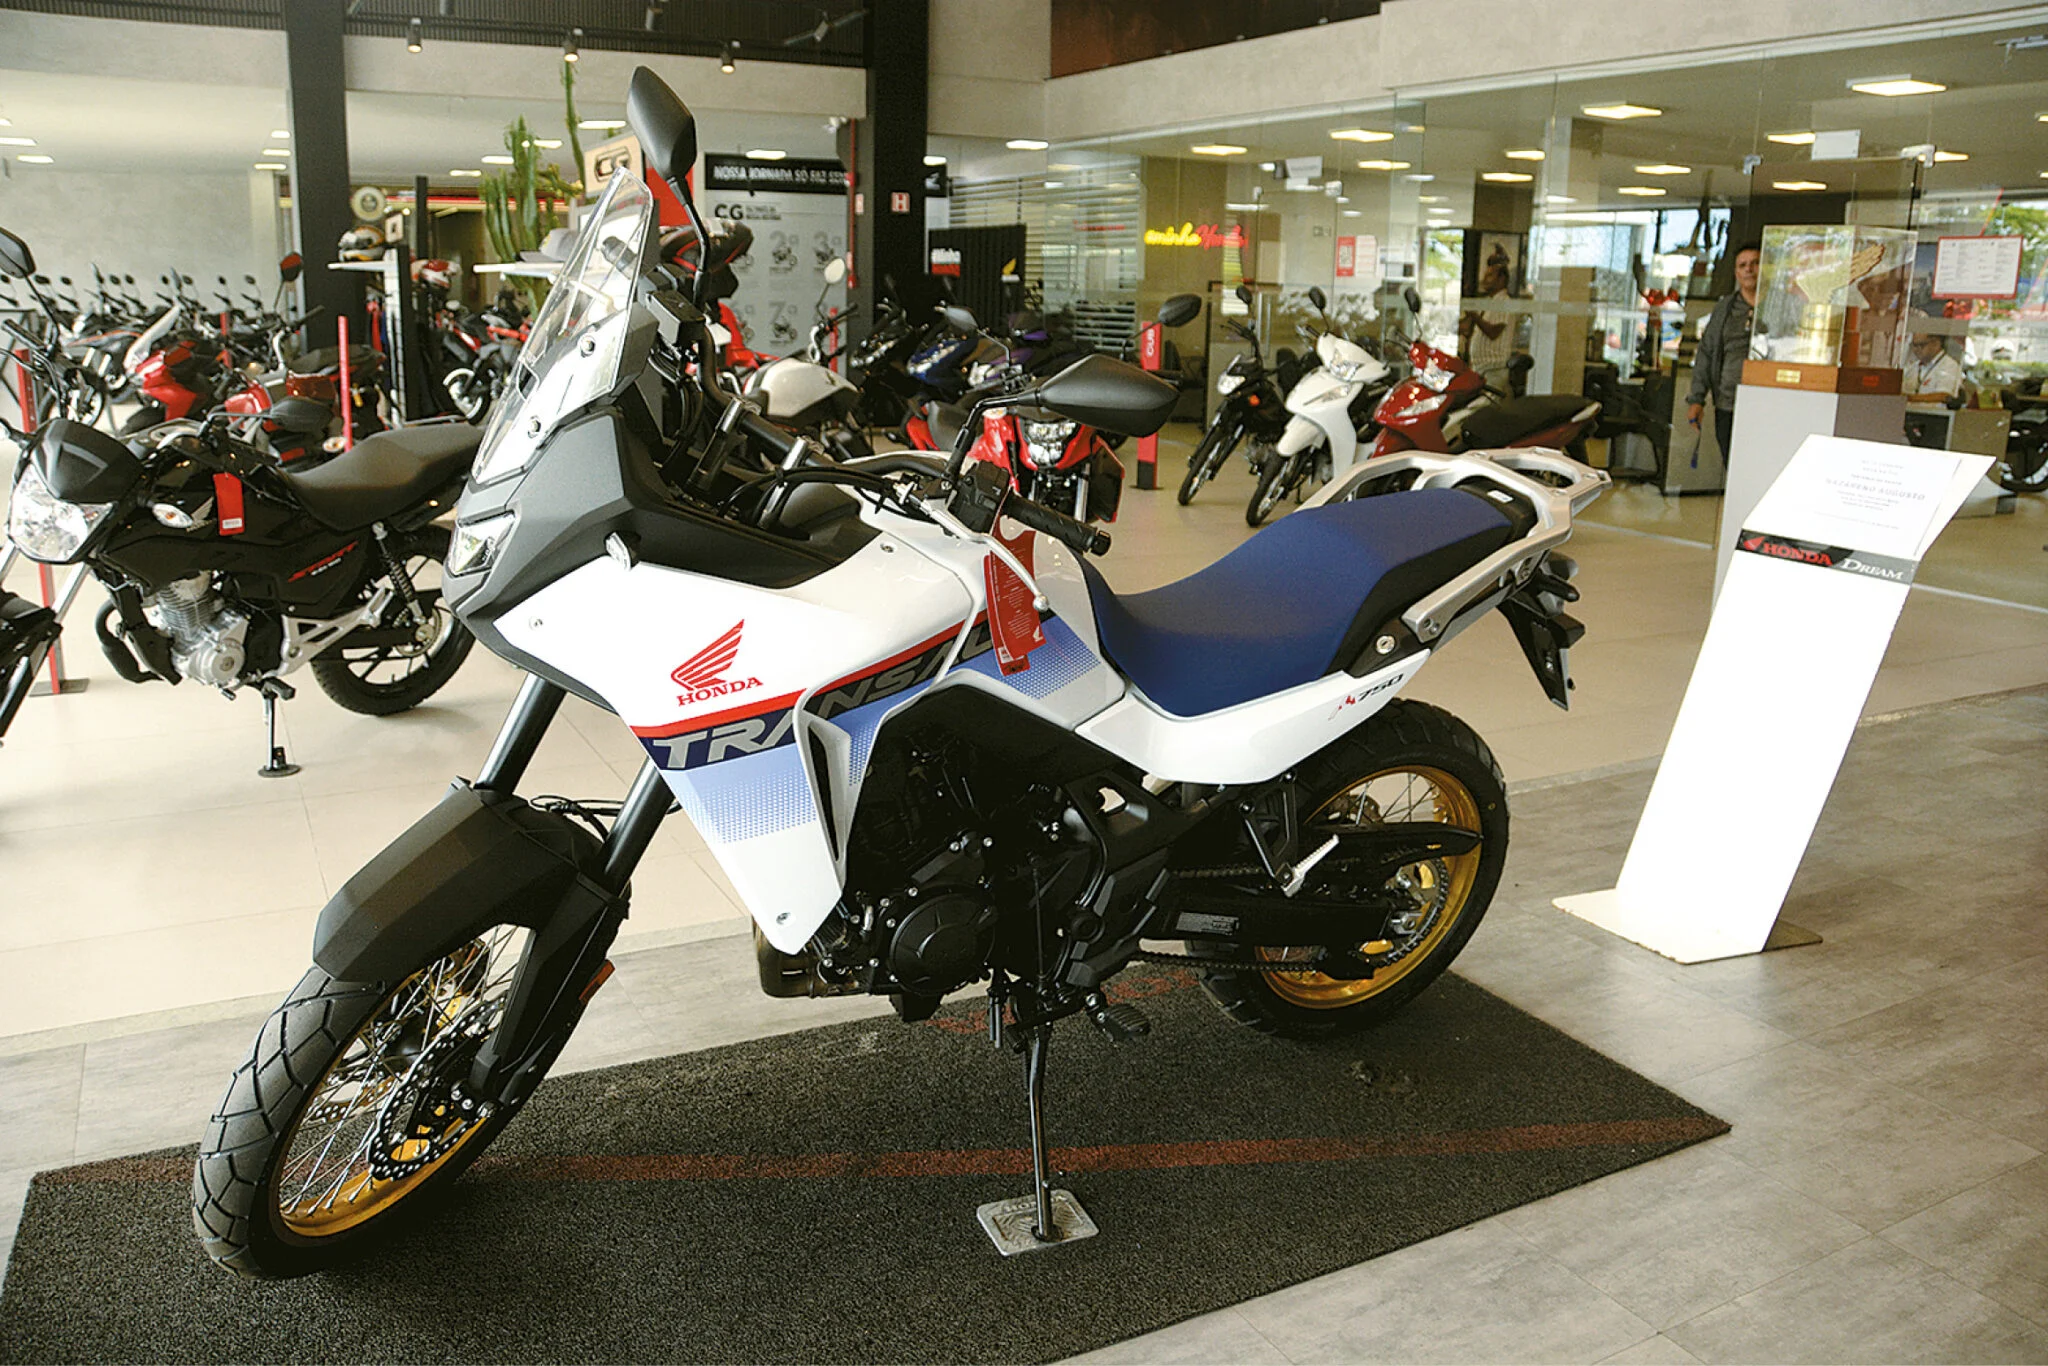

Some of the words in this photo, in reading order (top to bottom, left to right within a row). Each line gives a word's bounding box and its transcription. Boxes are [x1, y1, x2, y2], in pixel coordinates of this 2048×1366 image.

[713, 165, 748, 180] NOSSA
[748, 166, 794, 181] JORNADA
[714, 203, 744, 221] CG
[1147, 328, 1155, 357] CUB
[1763, 542, 1834, 567] HONDA
[1840, 558, 1904, 580] DREAM
[677, 676, 764, 706] HONDA
